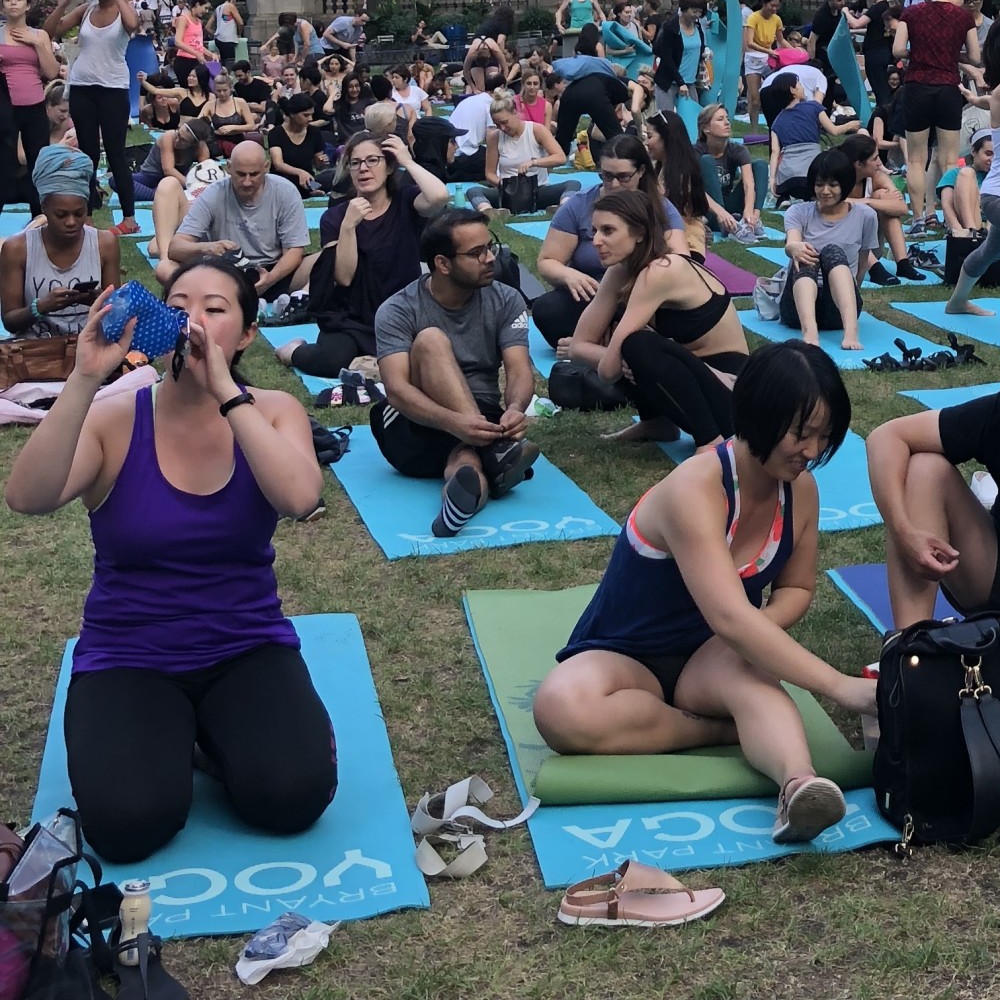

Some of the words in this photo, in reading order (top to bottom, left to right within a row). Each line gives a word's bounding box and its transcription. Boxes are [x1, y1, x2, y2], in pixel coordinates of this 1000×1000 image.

[207, 168, 218, 181] R
[561, 802, 861, 849] OGA
[712, 815, 873, 854] BRNT
[582, 844, 695, 870] PARK
[119, 848, 393, 906] YOG
[211, 881, 397, 918] BRYANT
